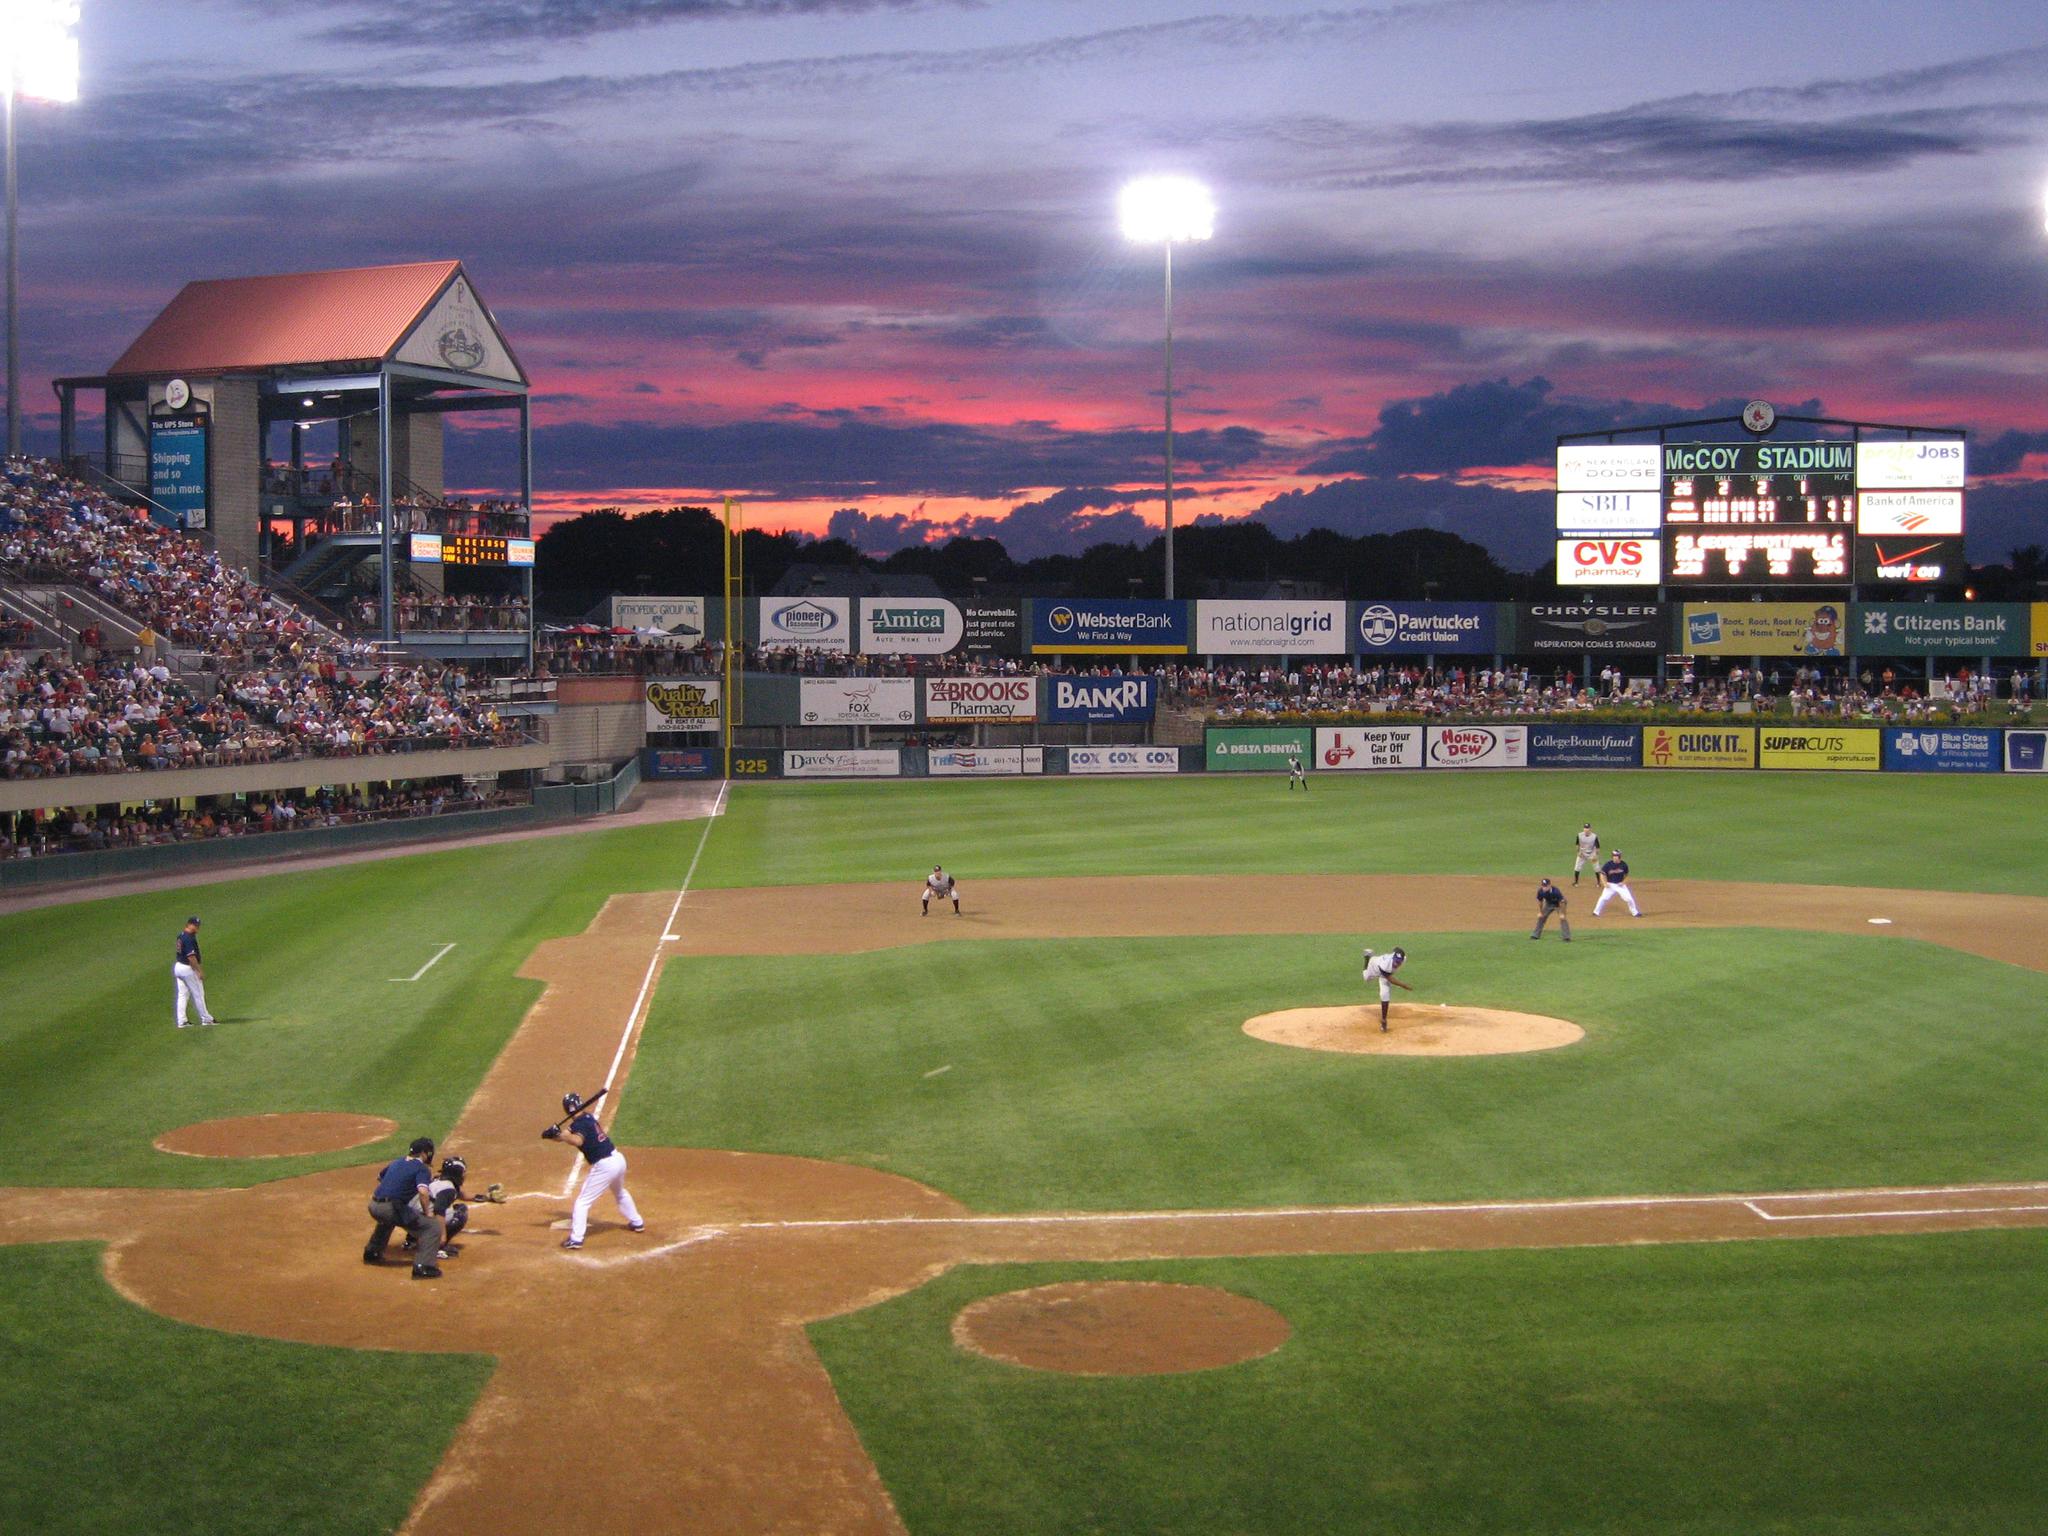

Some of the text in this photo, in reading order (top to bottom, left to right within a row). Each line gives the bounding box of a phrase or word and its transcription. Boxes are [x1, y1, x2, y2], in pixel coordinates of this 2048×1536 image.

[152, 452, 191, 466] Shipping
[1666, 447, 1852, 470] McCOY STADIUM
[154, 470, 181, 479] and so
[1586, 469, 1656, 478] DODGE
[154, 485, 204, 495] much more.
[1866, 496, 1954, 506] Bank of America
[1574, 542, 1643, 565] CVS
[1575, 568, 1642, 578] pharmacy
[1876, 563, 1941, 582] verizon
[616, 604, 657, 614] ORTHOPEDIC
[660, 604, 684, 614] GROUP
[1531, 606, 1657, 615] CHRYSLER
[786, 610, 824, 628] pioneer
[872, 609, 941, 628] Amica
[1076, 612, 1172, 628] WebsterBank
[1212, 610, 1332, 636] nationalgrid
[1399, 614, 1480, 630] Pawtucket
[1894, 615, 2006, 631] Citizens Bank
[1116, 632, 1132, 641] Way
[1230, 637, 1314, 647] www.nationalgrid.com
[1400, 632, 1459, 641] Credit Union
[1905, 636, 1921, 645] Not
[1923, 638, 1942, 646] your
[1944, 636, 1973, 646] typical
[647, 683, 706, 713] Quality
[948, 682, 1029, 701] BROOKS
[669, 699, 720, 718] Rental
[849, 704, 869, 712] FOX
[951, 702, 1015, 716] Pharmacy
[1364, 732, 1410, 742] Keep Your
[1442, 729, 1488, 745] HONEY
[1534, 736, 1634, 750] CollegeBoundfund
[1679, 734, 1747, 753] CLICK IT...
[1764, 736, 1844, 750] SUPERCUTS
[1230, 744, 1302, 754] DELTA DENTAL
[1371, 743, 1404, 753] Car Off
[1446, 744, 1482, 756] DEW
[790, 754, 834, 769] Dave's
[1071, 752, 1175, 764] COX COX COX
[1372, 755, 1402, 765] the DL
[736, 760, 768, 773] 325
